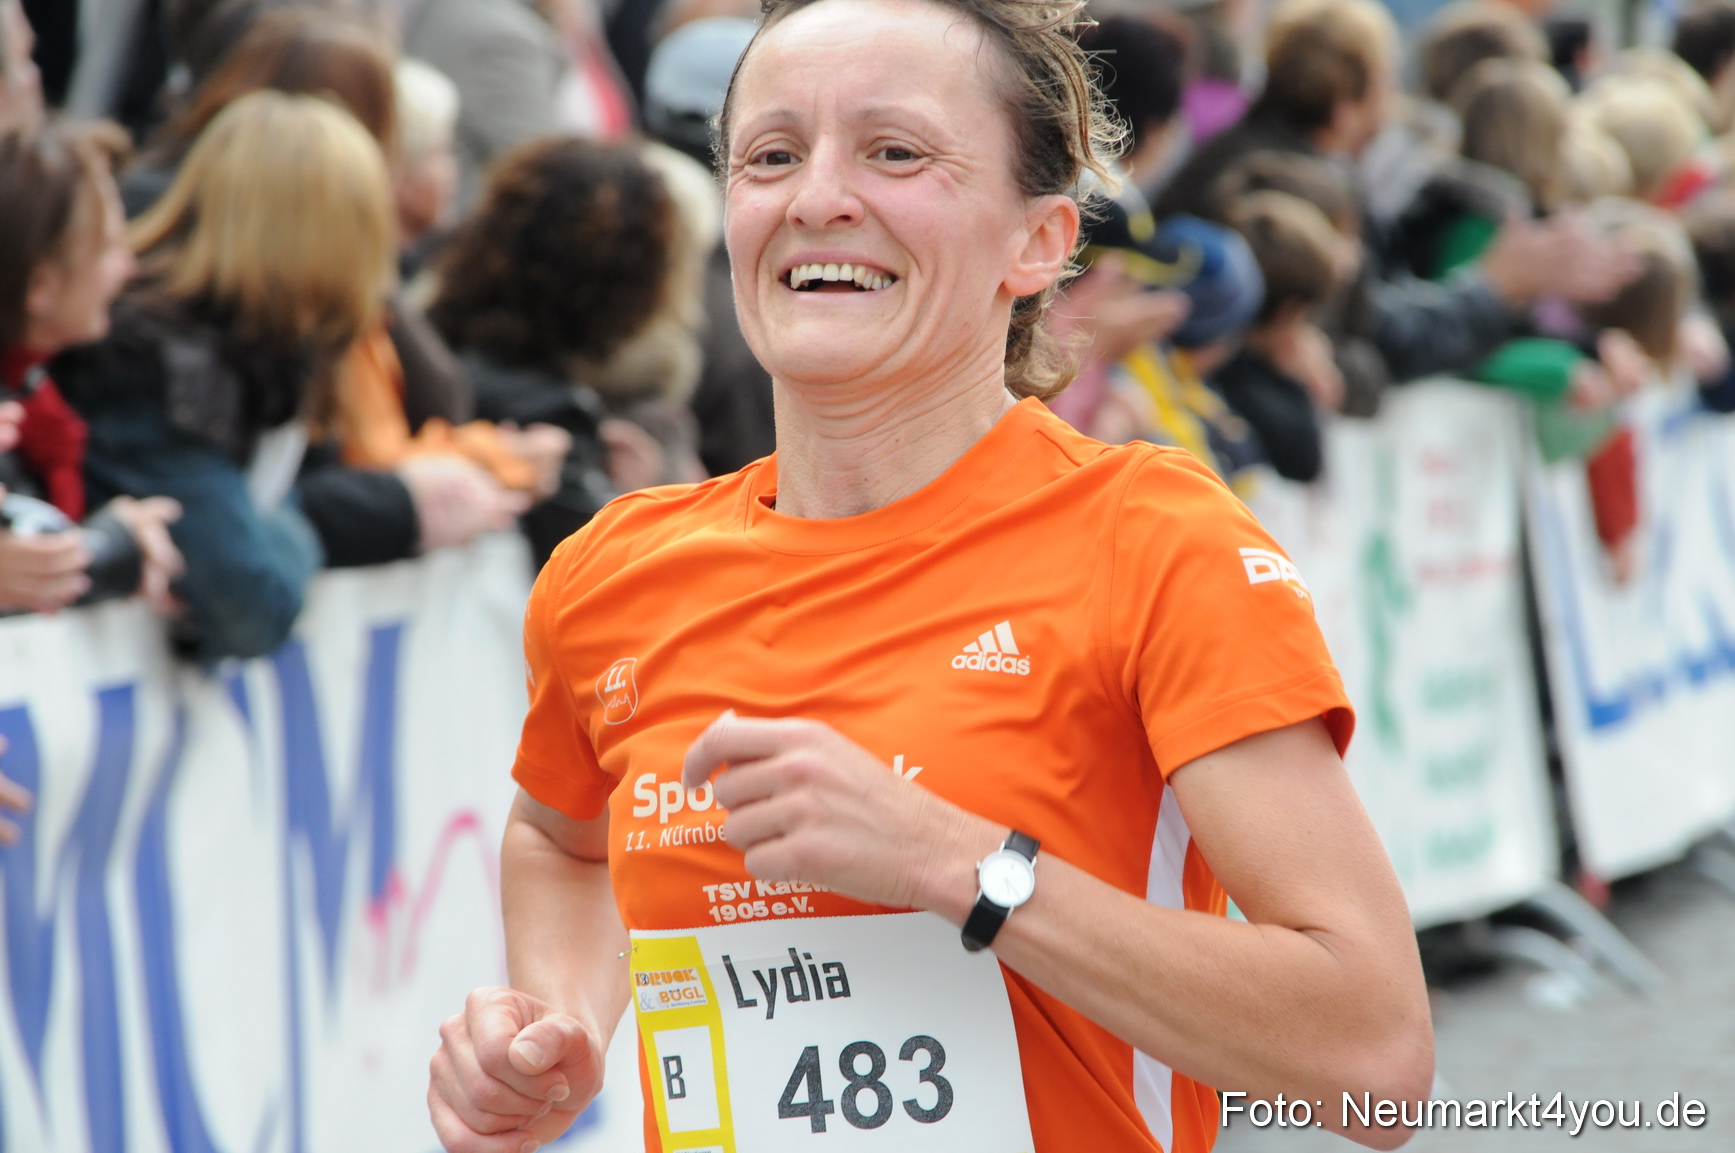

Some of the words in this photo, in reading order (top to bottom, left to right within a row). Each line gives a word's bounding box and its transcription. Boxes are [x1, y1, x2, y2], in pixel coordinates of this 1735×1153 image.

[951, 651, 1031, 676] adidas
[625, 830, 651, 852] 11.
[659, 821, 728, 848] Nürnbe
[702, 880, 751, 903] TSV
[755, 878, 842, 897] Katzw
[708, 899, 769, 923] 1905
[771, 895, 815, 917] e.V.
[659, 986, 705, 1003] BÖGL
[721, 947, 852, 1020] Lydia
[662, 1055, 687, 1100] B
[777, 1034, 954, 1134] 483
